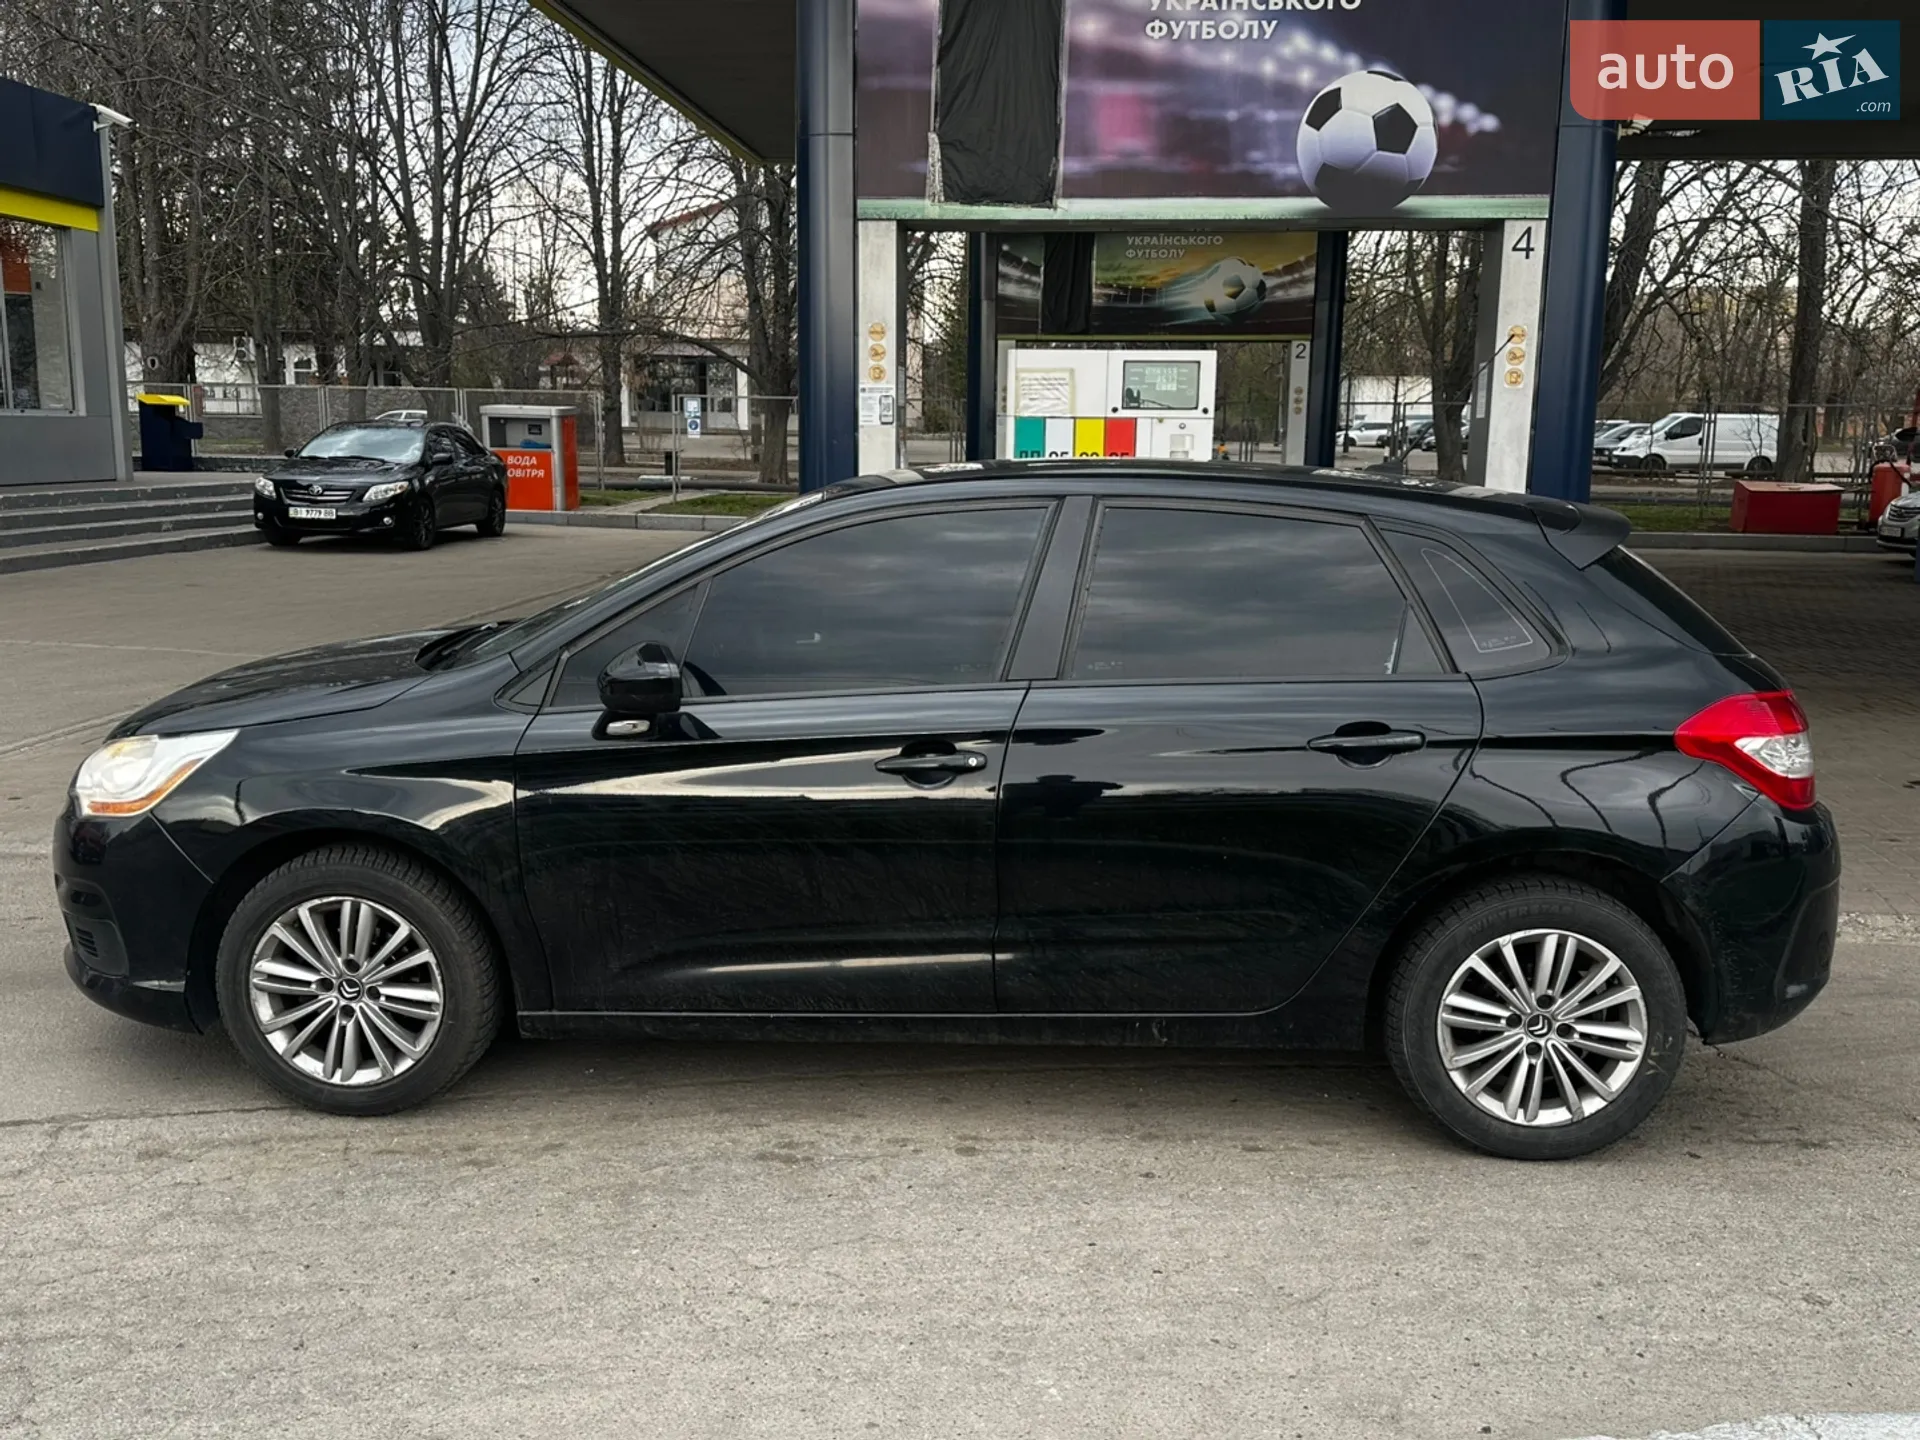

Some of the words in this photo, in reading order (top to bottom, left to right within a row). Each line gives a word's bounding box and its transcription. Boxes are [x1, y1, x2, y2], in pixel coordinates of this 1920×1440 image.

[1145, 19, 1278, 40] ФУТБОЛУ
[1126, 233, 1224, 246] УКРАЇНСЬКОГО
[1511, 226, 1535, 260] 4
[1125, 248, 1186, 259] ФУТБОЛУ
[1295, 343, 1307, 359] 2
[507, 455, 538, 466] ВОДА
[507, 468, 545, 478] ОВІТРЯ
